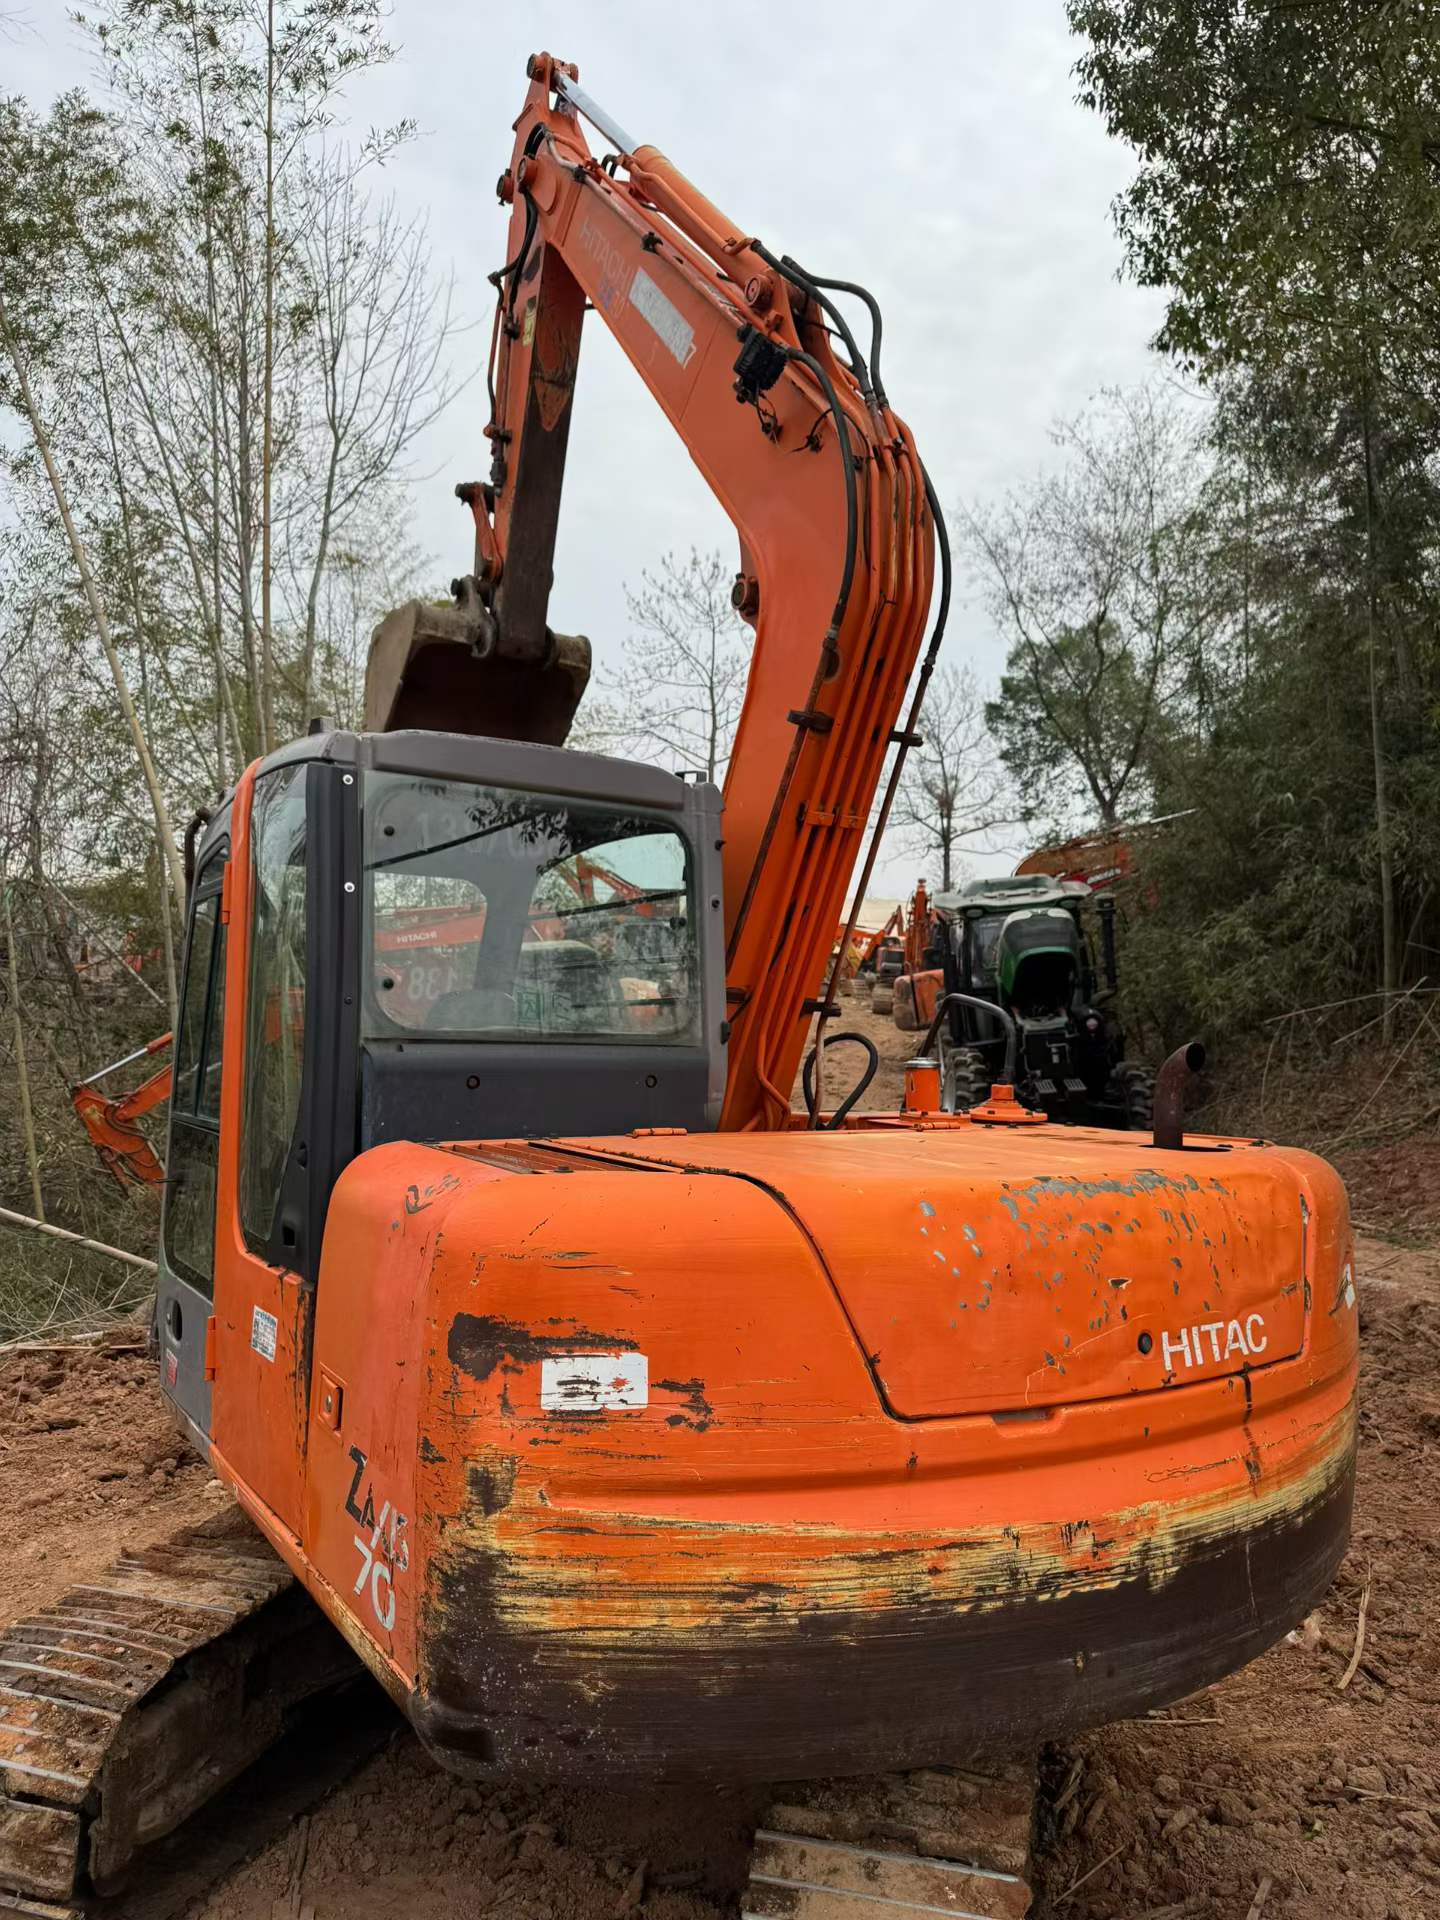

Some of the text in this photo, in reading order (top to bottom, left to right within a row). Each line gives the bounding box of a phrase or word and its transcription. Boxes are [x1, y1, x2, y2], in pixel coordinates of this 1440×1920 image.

[396, 930, 438, 944] HITACHI
[1161, 1313, 1267, 1371] HITAC
[353, 1534, 396, 1631] 70
